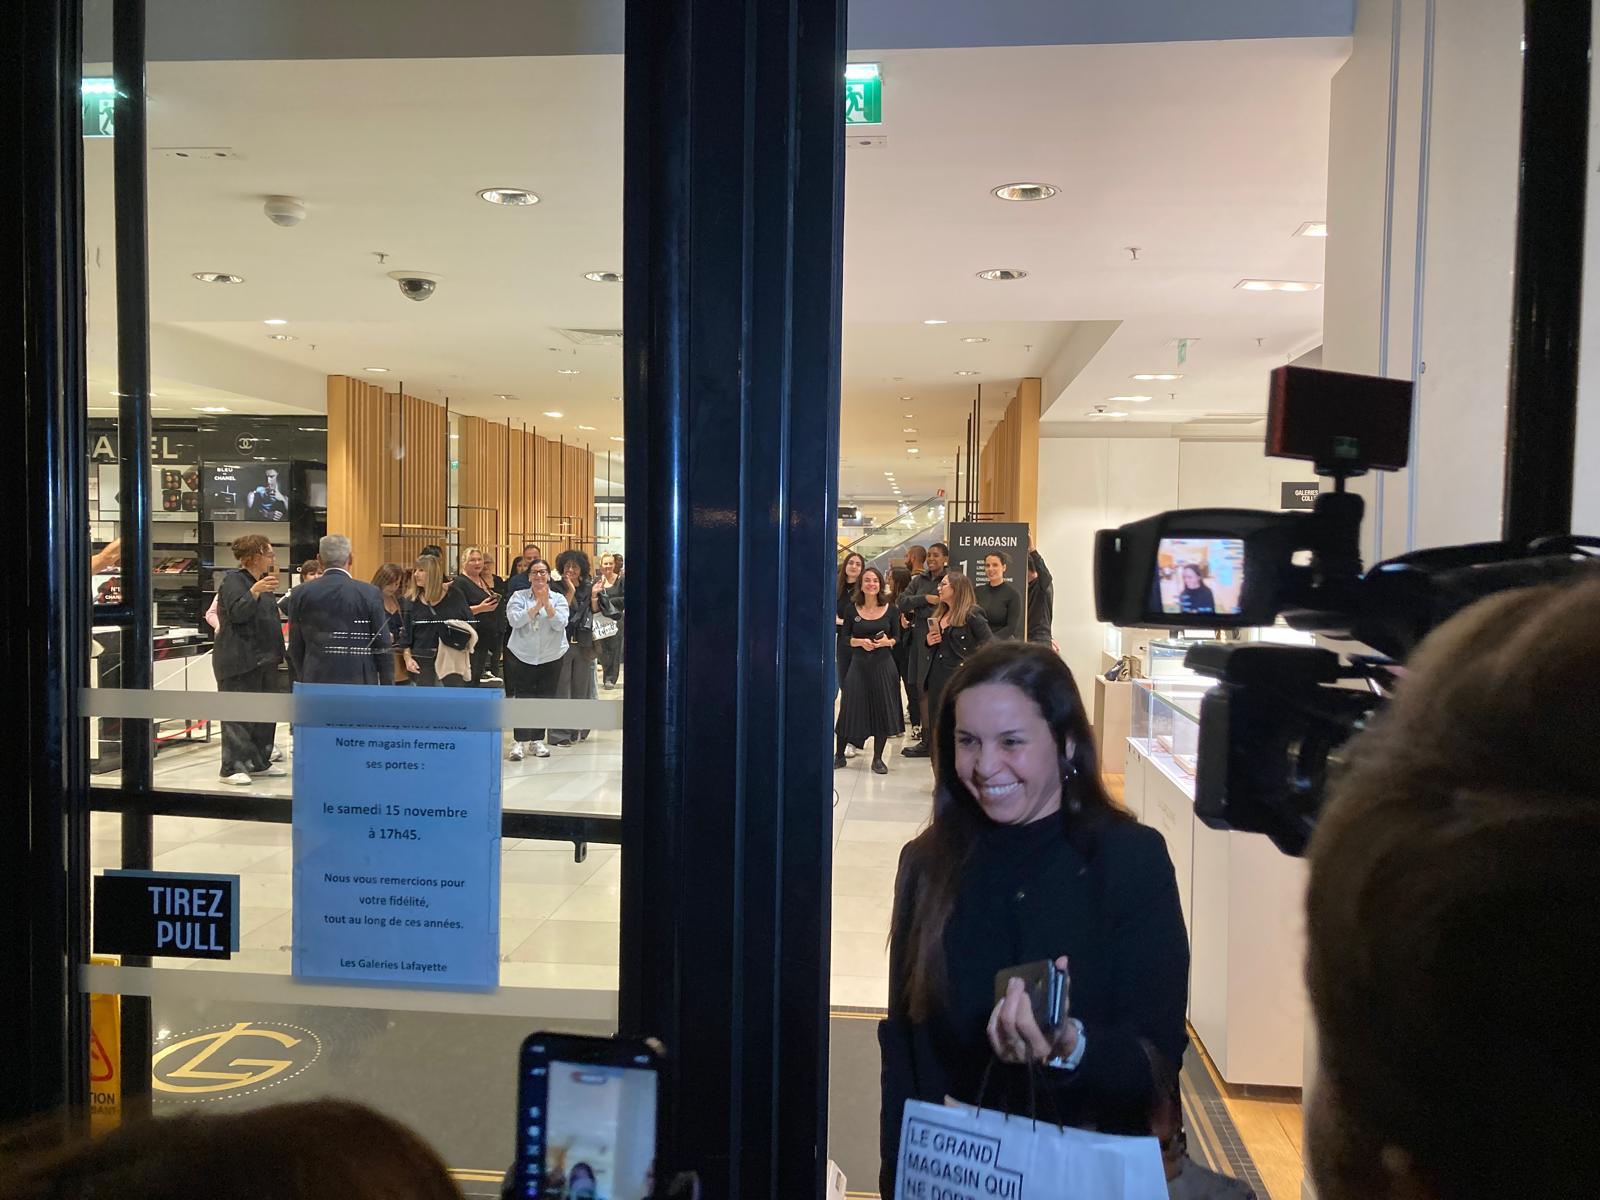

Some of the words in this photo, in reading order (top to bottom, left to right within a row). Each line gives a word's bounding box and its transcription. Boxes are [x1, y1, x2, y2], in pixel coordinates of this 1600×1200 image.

[959, 536, 971, 547] LE
[973, 536, 1018, 547] MAGASIN
[335, 737, 366, 748] Notre
[368, 738, 411, 751] magasin
[413, 738, 456, 750] fermera
[365, 761, 383, 769] ses
[385, 760, 419, 771] portes
[323, 802, 334, 814] le
[337, 803, 382, 815] samedi
[386, 804, 400, 816] 15
[403, 806, 468, 818] novembre
[368, 827, 376, 839] à
[379, 828, 421, 841] 17h45.
[323, 872, 351, 883] Nous
[353, 875, 377, 885] vous
[379, 875, 438, 887] remercions
[440, 879, 465, 889] pour
[148, 886, 224, 918] TIREZ
[359, 896, 387, 906] votre
[389, 895, 429, 909] fidélité,
[324, 914, 346, 924] tout
[349, 916, 361, 925] au
[364, 915, 386, 928] long
[389, 916, 402, 927] de
[404, 918, 421, 928] ces
[423, 918, 465, 929] années.
[156, 920, 224, 951] PULL
[340, 958, 356, 968] Les
[358, 958, 399, 970] Galeries
[401, 960, 448, 973] Lafayette
[909, 1128, 931, 1148] LE
[932, 1133, 994, 1165] GRAND
[907, 1152, 981, 1190] MAGASIN
[984, 1174, 1017, 1200] QUI
[906, 1177, 927, 1198] NE
